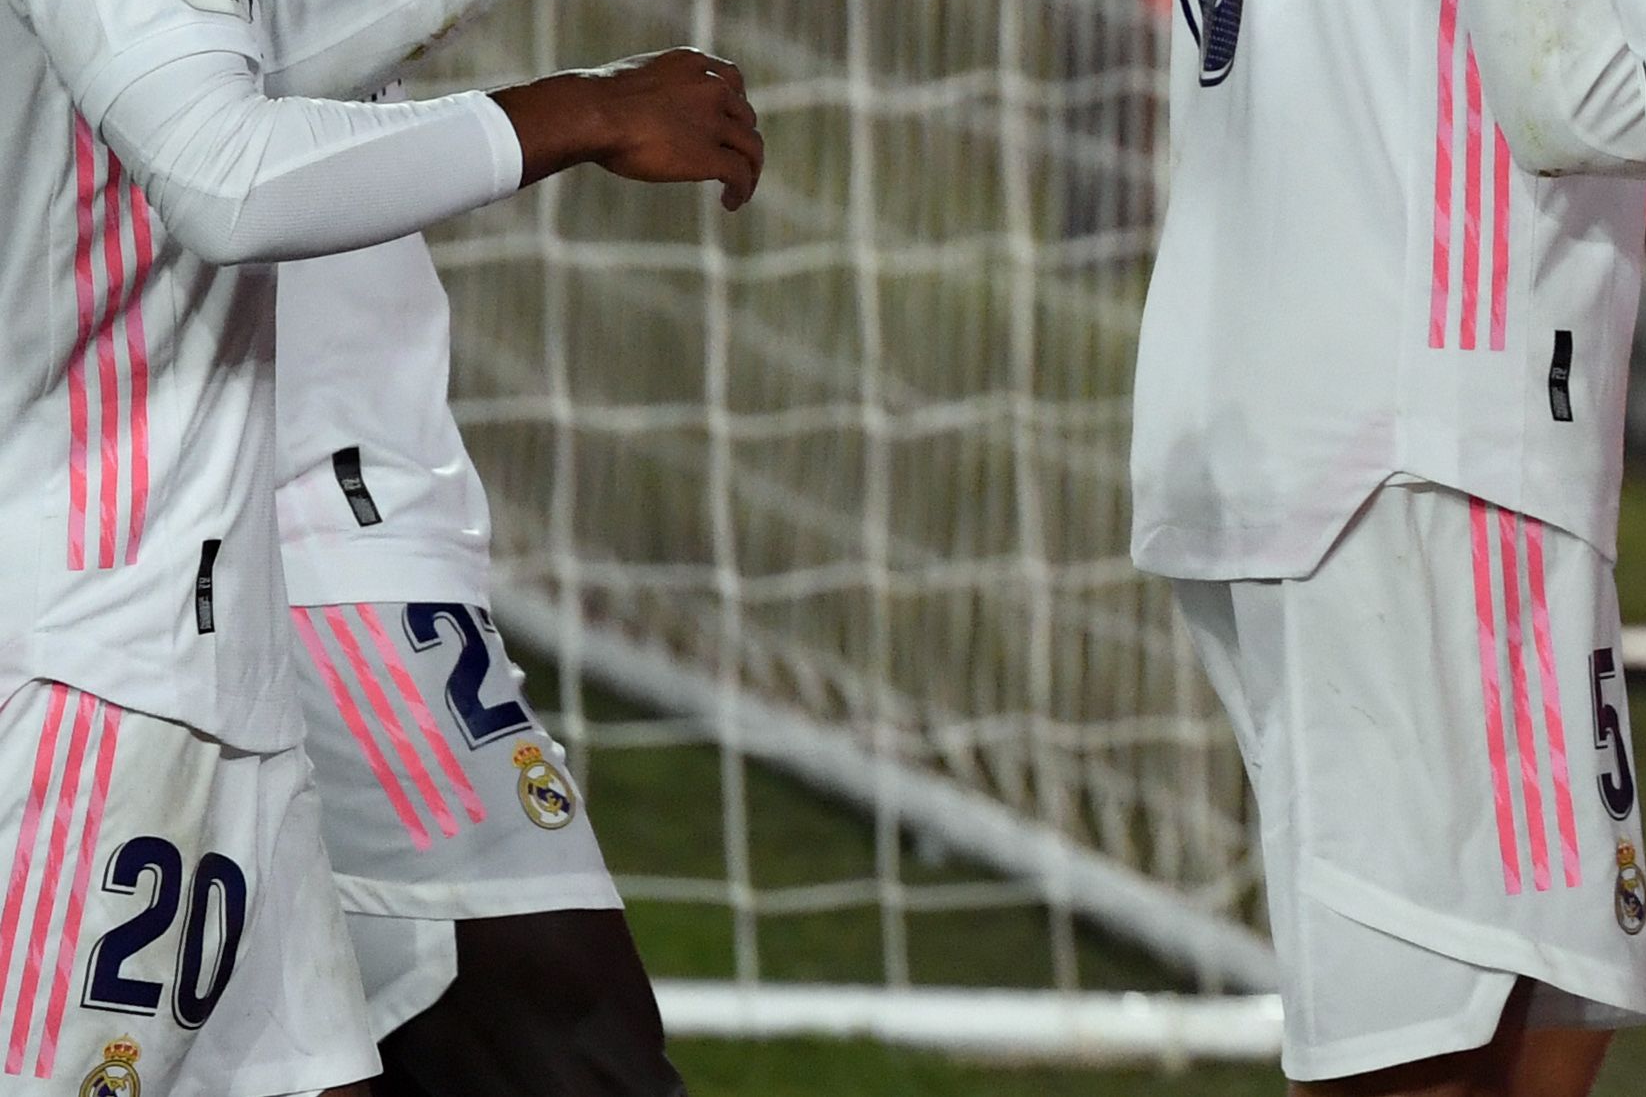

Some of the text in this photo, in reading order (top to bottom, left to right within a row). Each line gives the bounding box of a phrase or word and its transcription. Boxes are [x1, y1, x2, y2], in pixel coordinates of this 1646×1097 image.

[402, 602, 533, 751] 2
[1589, 647, 1634, 822] 5
[79, 835, 247, 1031] 20
